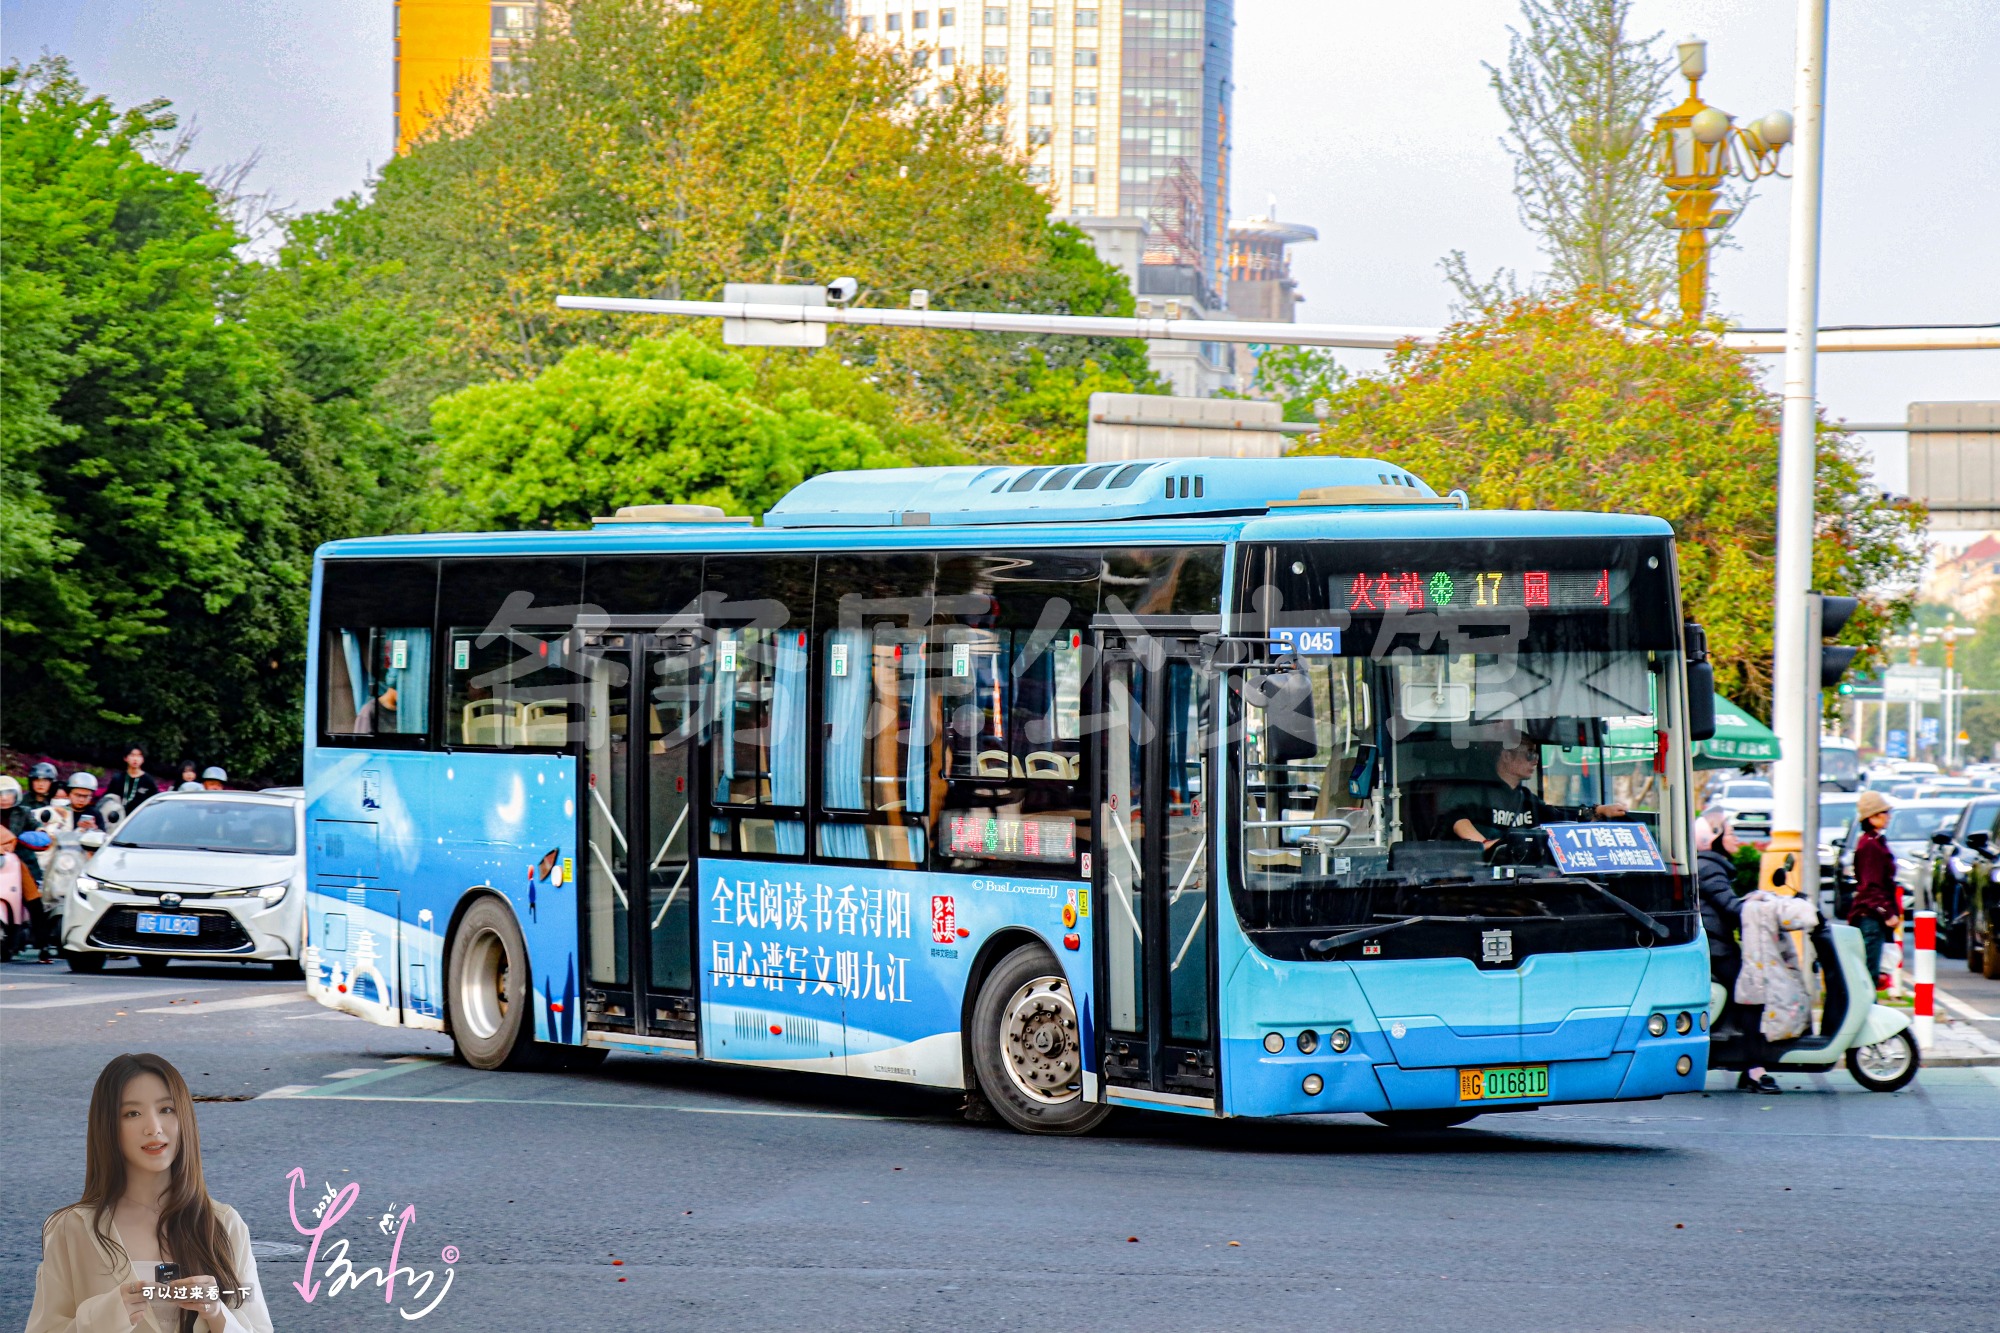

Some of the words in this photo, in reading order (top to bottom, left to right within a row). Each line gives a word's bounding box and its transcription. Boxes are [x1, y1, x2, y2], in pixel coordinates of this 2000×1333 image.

[1350, 572, 1424, 610] 火车站
[1476, 572, 1503, 606] 17
[1524, 570, 1549, 607] 园
[1280, 631, 1294, 651] B
[1299, 631, 1334, 651] 045
[1003, 821, 1020, 853] 17
[1565, 827, 1638, 848] 17路南
[1567, 850, 1598, 868] 火车站
[711, 876, 911, 939] 全民阅读书香浔阳
[712, 939, 912, 1004] 同心谱写文明九江
[1488, 1071, 1546, 1094] 01681D
